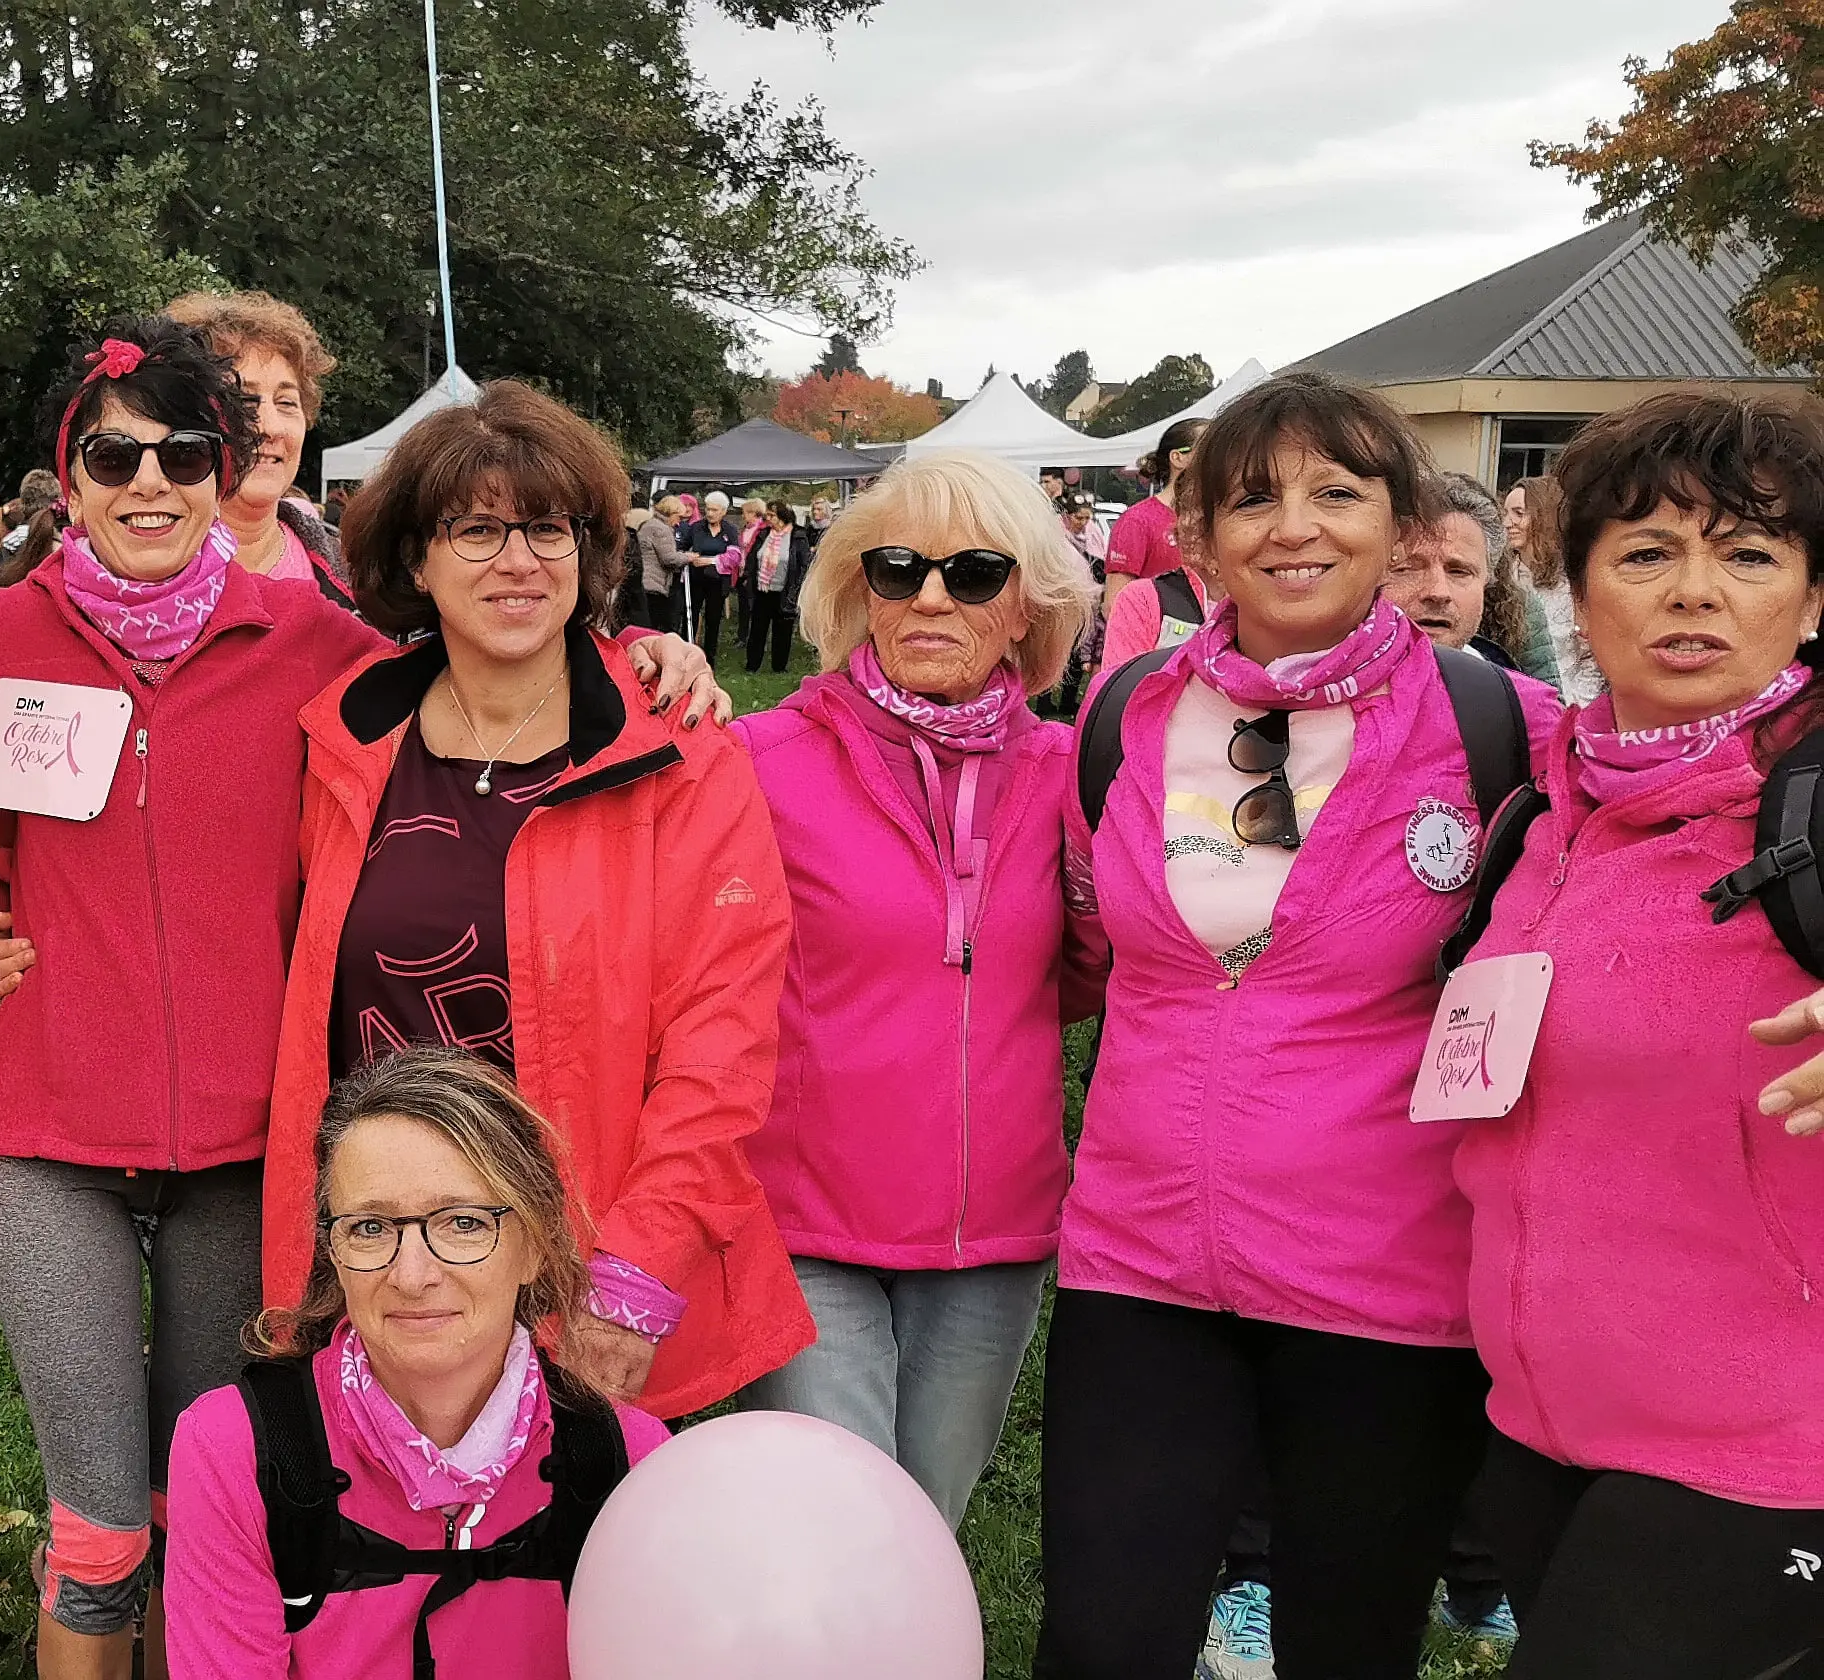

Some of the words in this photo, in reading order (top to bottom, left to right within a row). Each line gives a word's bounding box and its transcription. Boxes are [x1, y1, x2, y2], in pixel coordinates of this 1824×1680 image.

[15, 697, 45, 712] DIM
[3, 721, 65, 747] Octobre
[10, 742, 49, 774] Rose
[1406, 804, 1436, 850] FITNESS
[1416, 864, 1462, 890] RYTHME
[1448, 1006, 1470, 1024] DIM
[1436, 1033, 1481, 1071] Octobre
